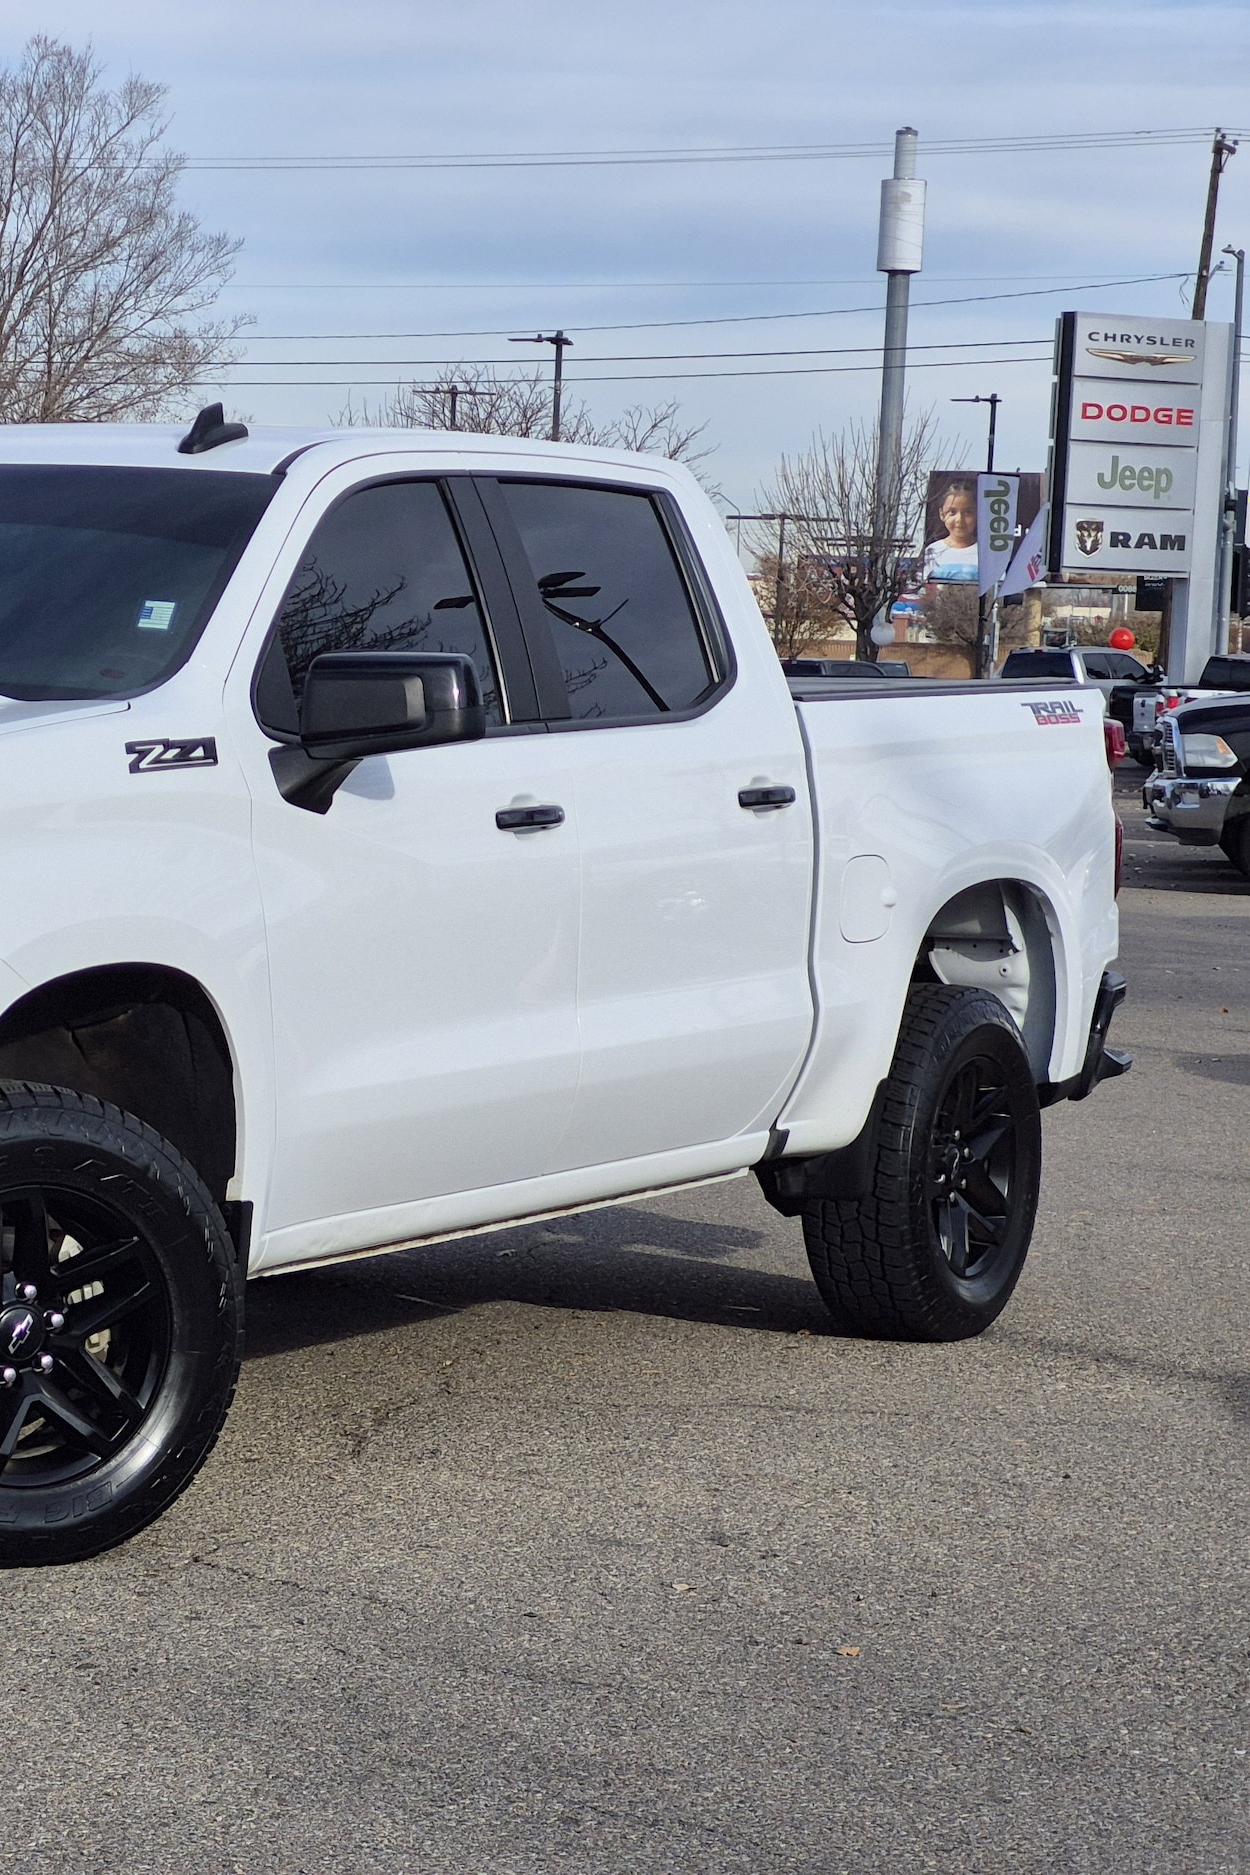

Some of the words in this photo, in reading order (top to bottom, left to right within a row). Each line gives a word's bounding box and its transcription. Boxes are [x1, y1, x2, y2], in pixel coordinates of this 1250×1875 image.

[1088, 331, 1196, 348] CHRYSLER
[1081, 402, 1194, 426] DODGE
[1097, 455, 1173, 500] Jeep
[1109, 531, 1186, 551] RAM
[1020, 700, 1084, 715] TRAIL
[1035, 713, 1081, 726] BOSS
[125, 736, 218, 774] Z71
[44, 1480, 113, 1523] BIG
